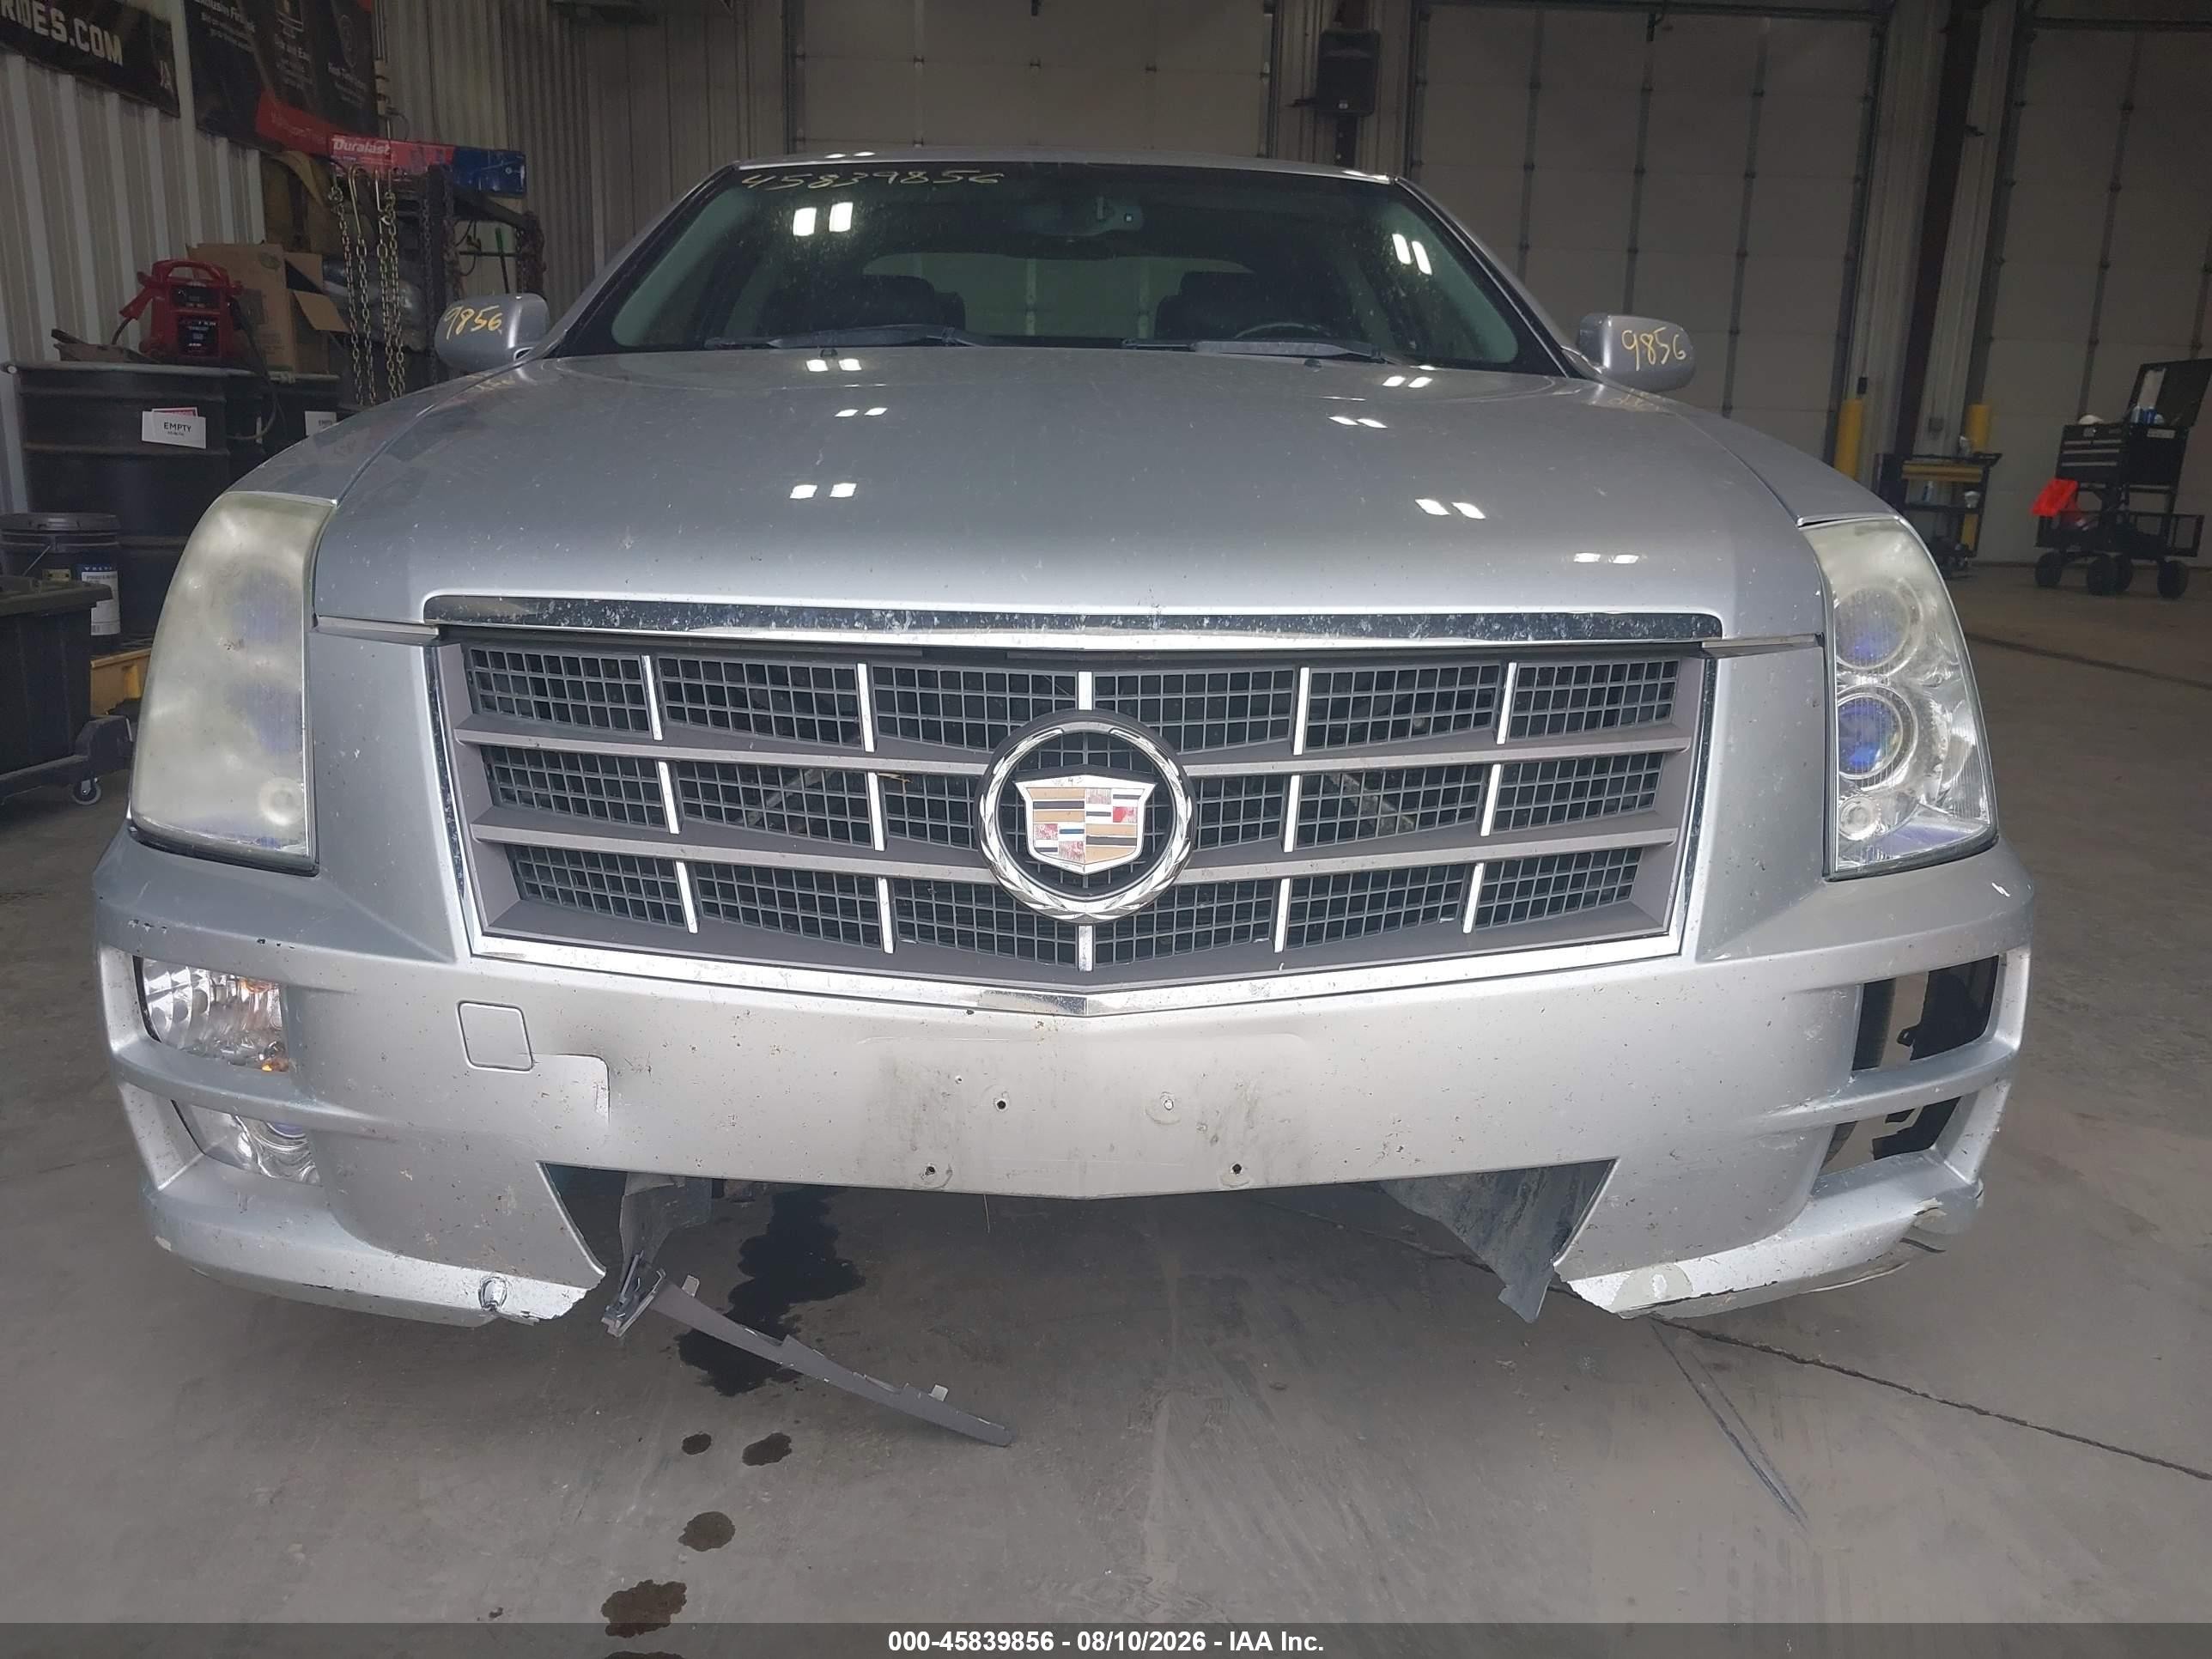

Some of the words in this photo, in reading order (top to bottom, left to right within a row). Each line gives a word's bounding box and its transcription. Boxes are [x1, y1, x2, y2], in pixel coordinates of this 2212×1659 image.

[331, 137, 391, 155] Duralast
[741, 170, 1005, 191] 45839856
[444, 305, 503, 340] 9856
[1621, 326, 1686, 371] 9856
[163, 422, 191, 433] EMPTY
